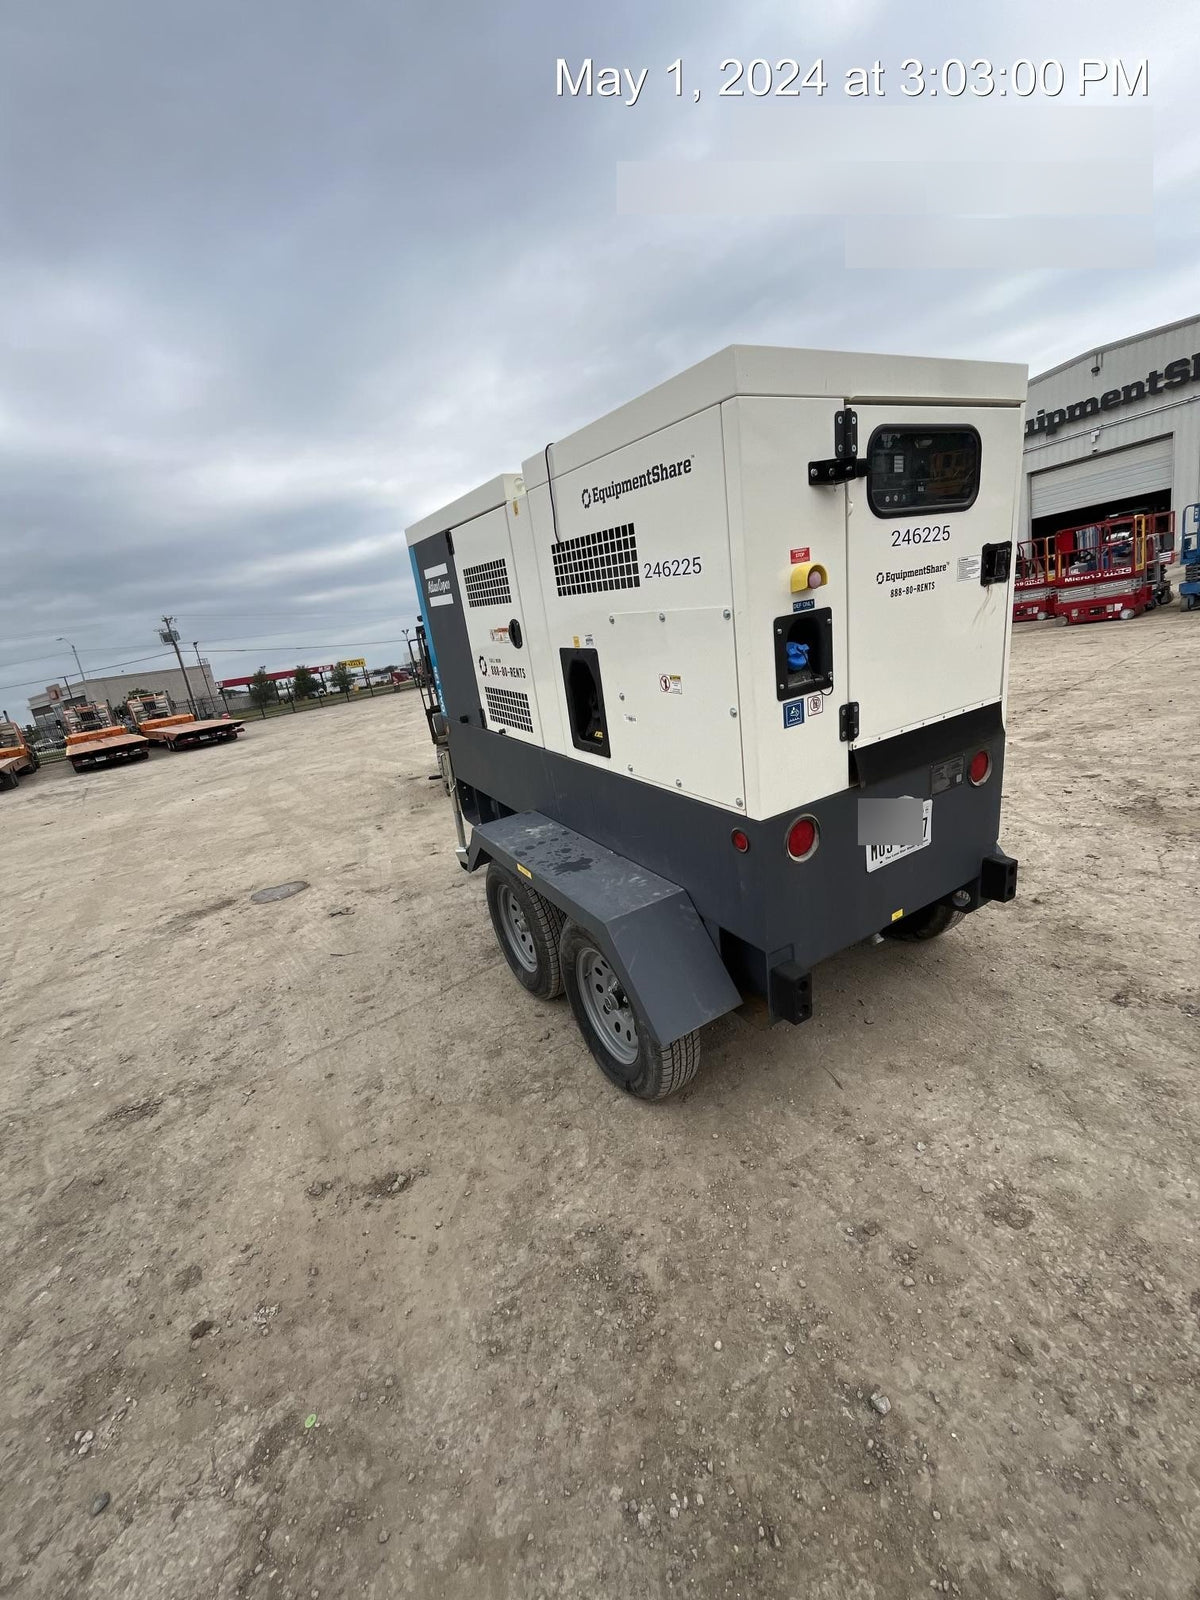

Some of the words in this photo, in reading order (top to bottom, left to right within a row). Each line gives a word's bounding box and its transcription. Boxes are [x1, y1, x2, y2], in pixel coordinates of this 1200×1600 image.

[1024, 352, 1200, 436] uipmentS
[591, 458, 692, 503] EquipmentShare
[892, 525, 951, 548] 246225
[643, 556, 702, 579] 246225
[885, 563, 947, 582] EquipmentShare
[890, 581, 936, 598] 888-80-RENTS
